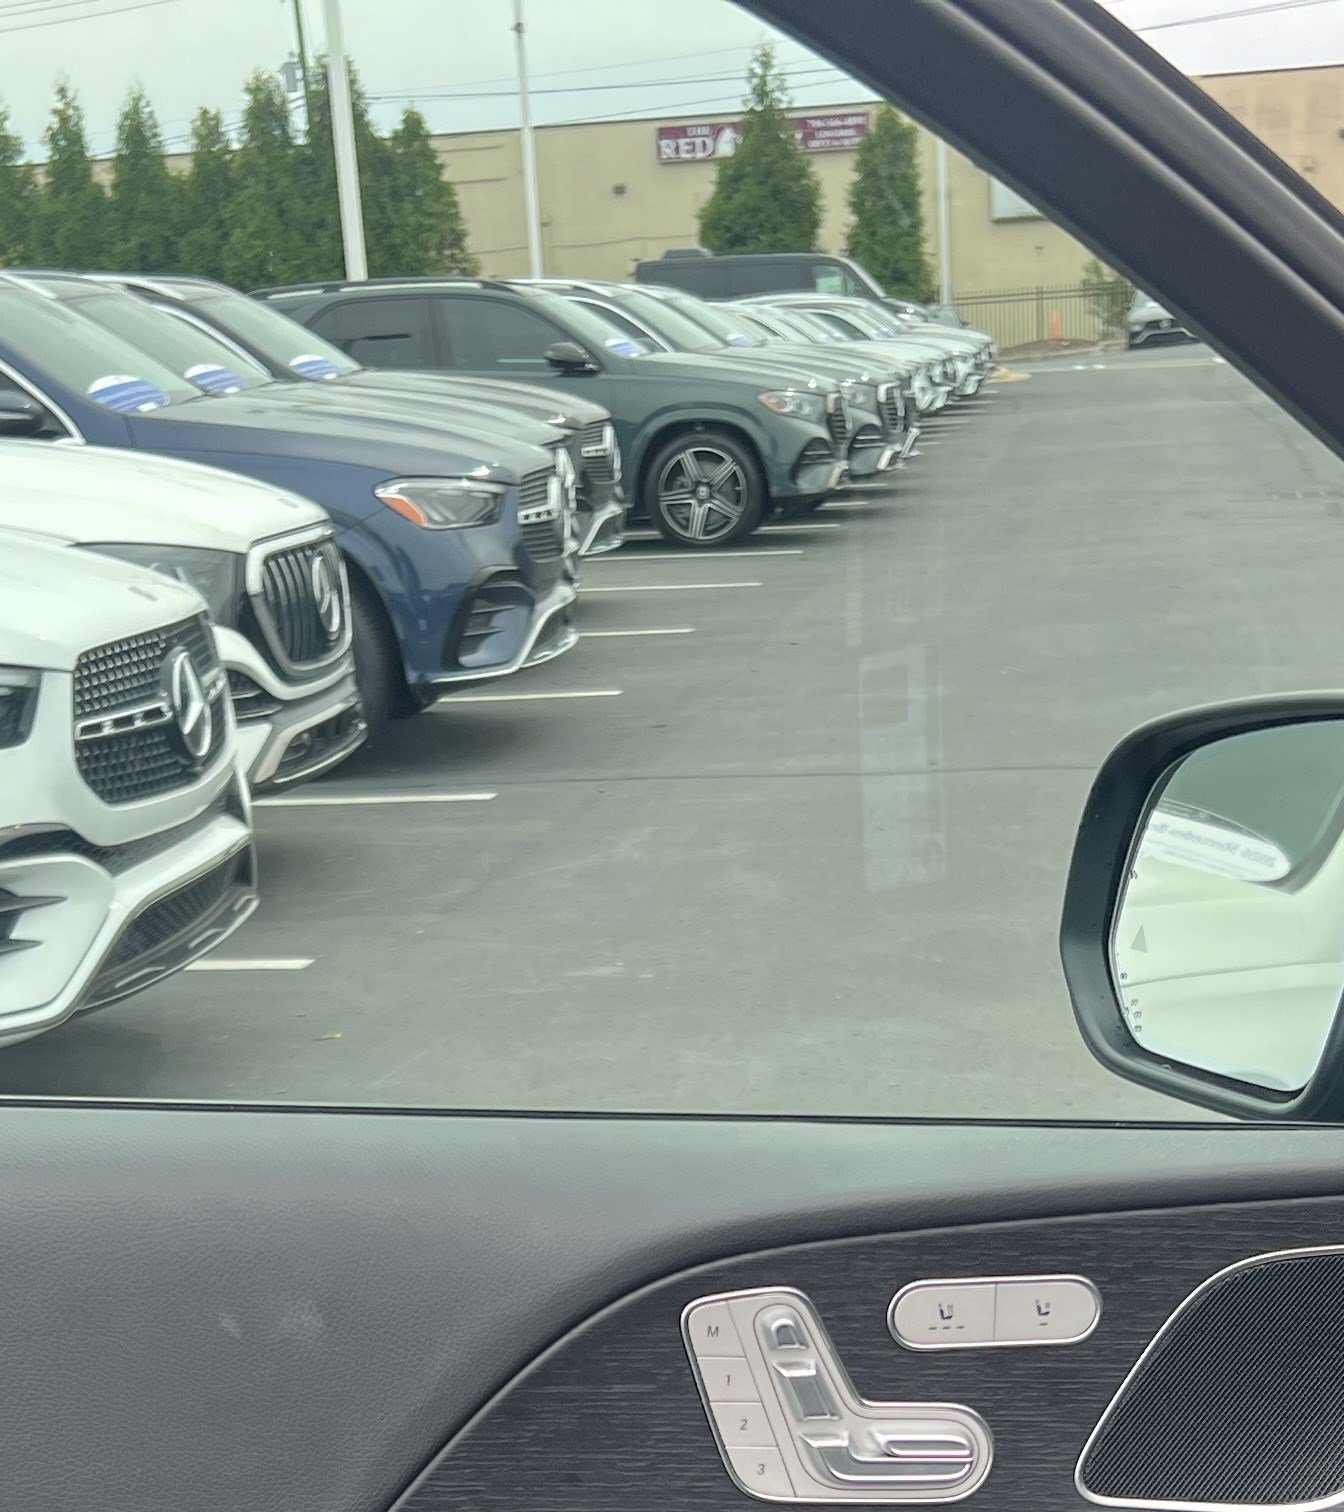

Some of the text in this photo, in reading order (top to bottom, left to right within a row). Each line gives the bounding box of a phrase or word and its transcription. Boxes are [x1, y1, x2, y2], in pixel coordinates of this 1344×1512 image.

[658, 137, 714, 159] RED
[706, 1326, 720, 1338] M
[725, 1374, 732, 1387] 1
[739, 1418, 749, 1432] 2
[756, 1463, 766, 1477] 3
